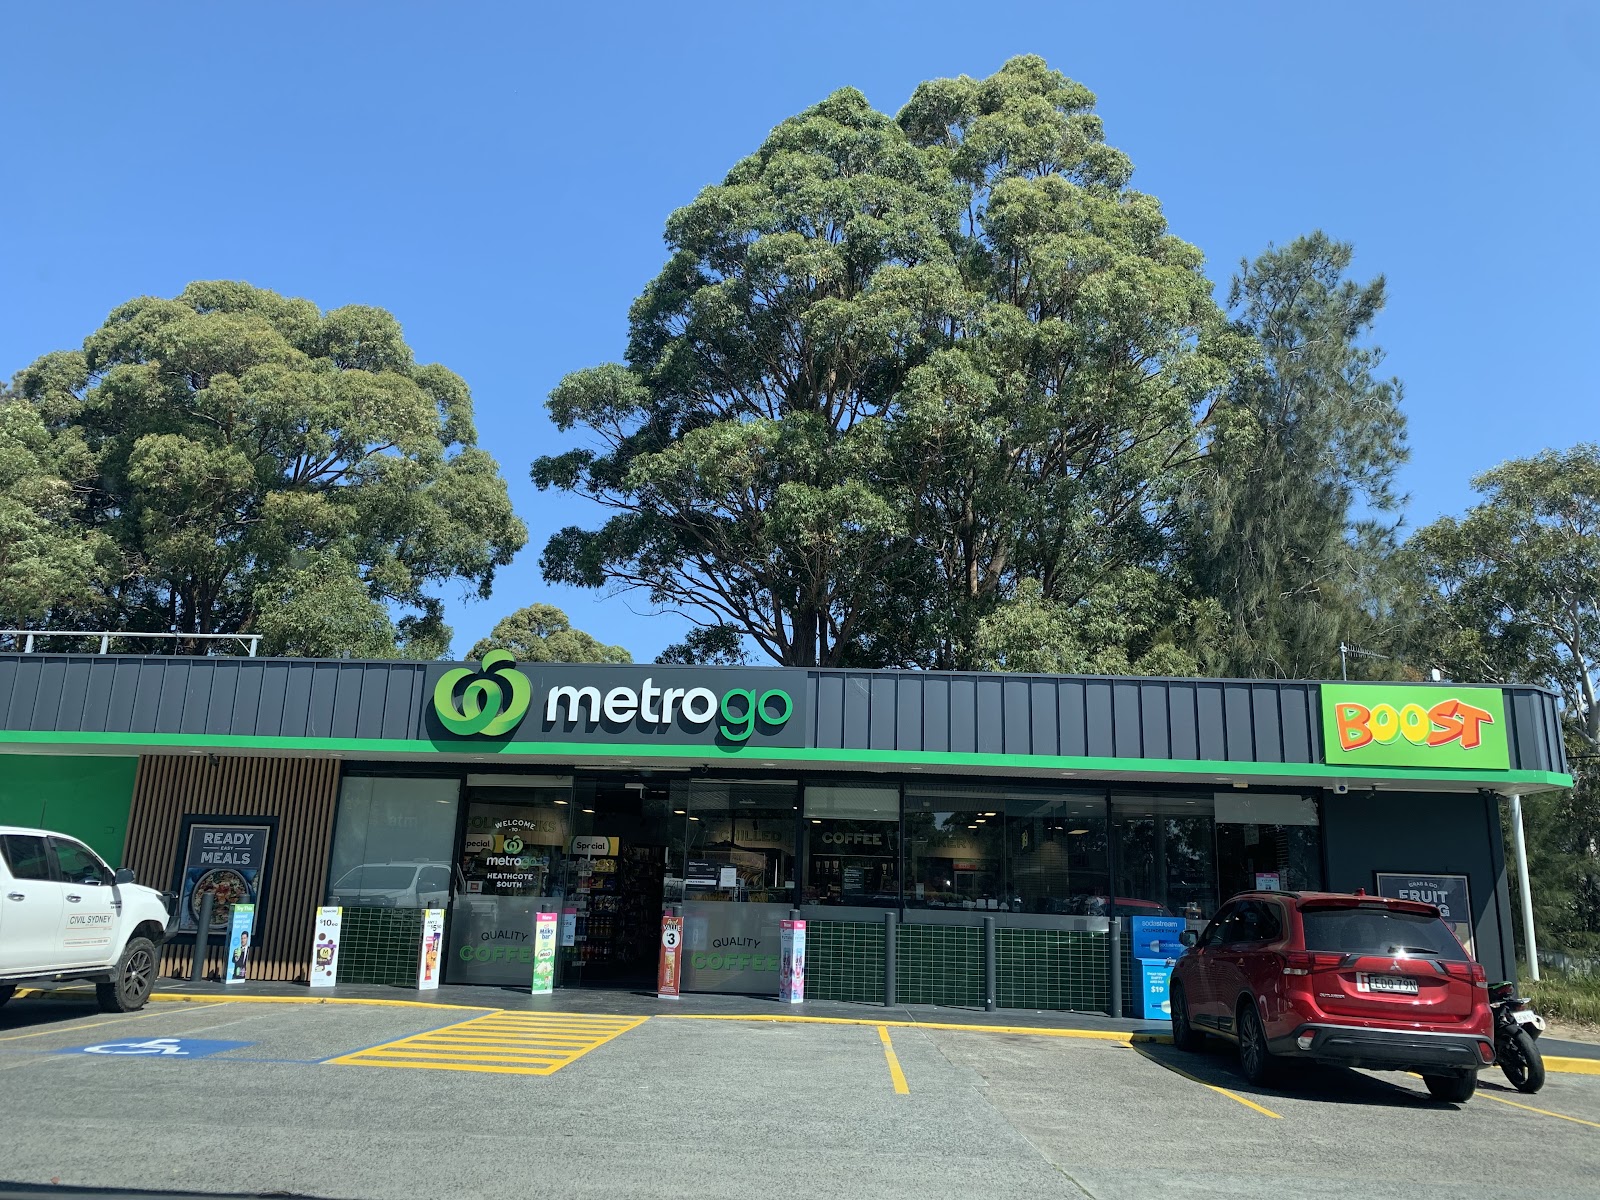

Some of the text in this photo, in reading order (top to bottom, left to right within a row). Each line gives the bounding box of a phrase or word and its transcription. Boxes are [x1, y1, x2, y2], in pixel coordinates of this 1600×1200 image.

[1335, 698, 1495, 751] BOOST
[495, 819, 536, 831] WELCOME
[203, 832, 254, 845] READY
[466, 840, 490, 849] pecial
[822, 832, 882, 845] COFFEE
[200, 852, 250, 865] MEALS
[487, 872, 534, 880] HEATHCOTE
[1399, 890, 1448, 903] FRUIT
[69, 915, 111, 924] CIVIL SYDNEY
[481, 930, 528, 942] QUALITY
[712, 937, 760, 948] QUALITY
[460, 945, 531, 963] COFFE
[691, 951, 780, 971] COFFEE
